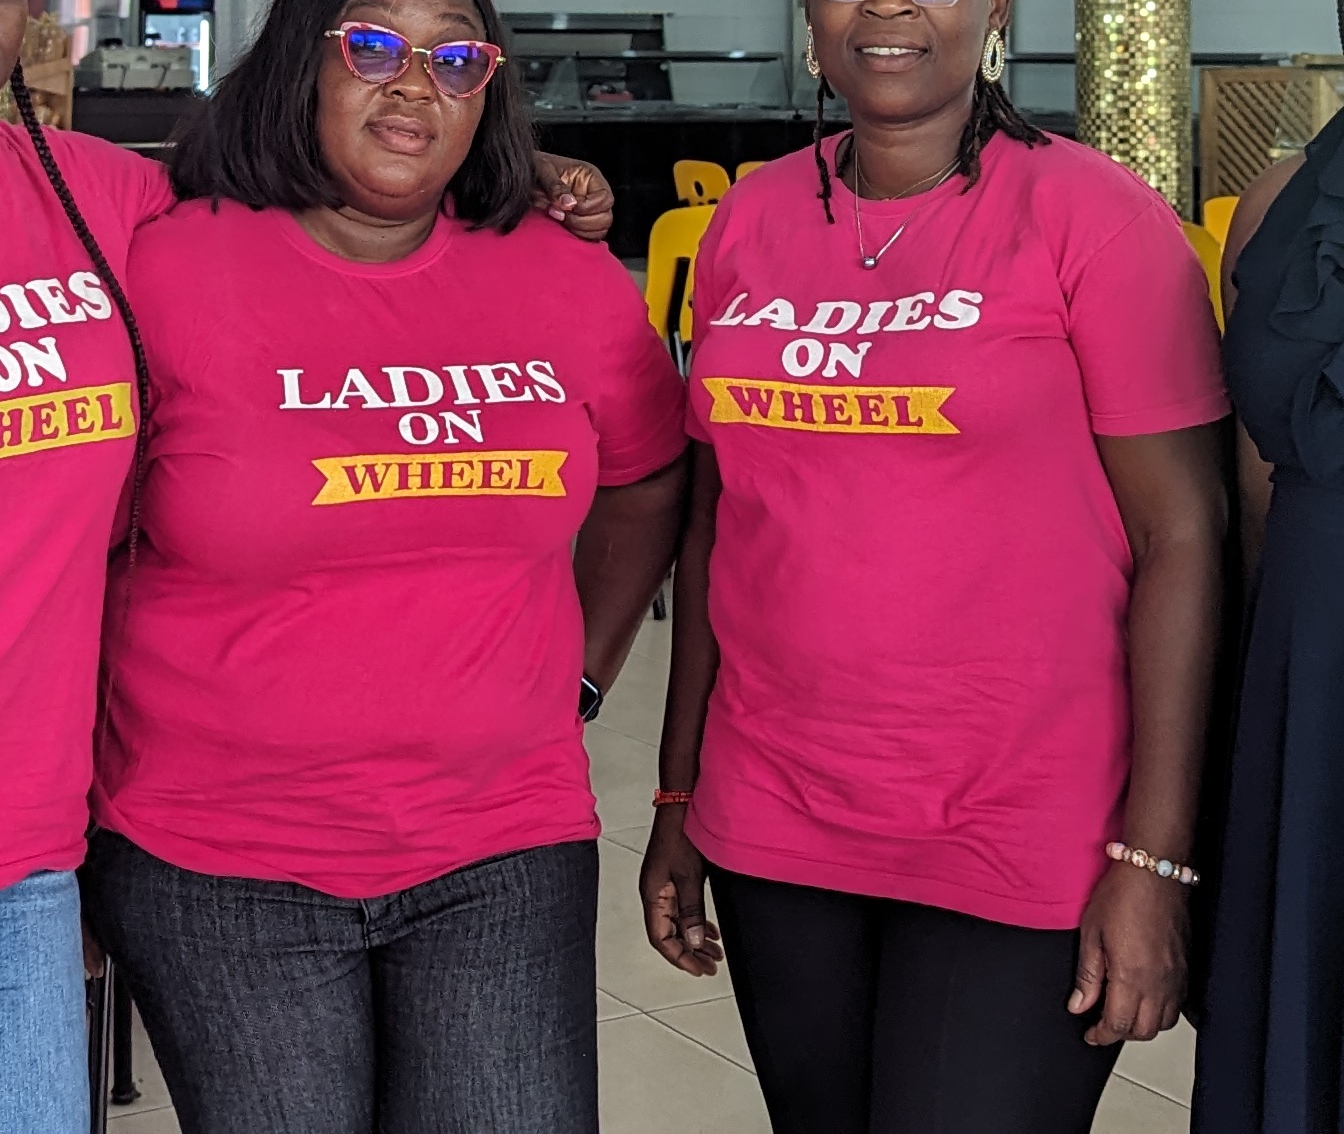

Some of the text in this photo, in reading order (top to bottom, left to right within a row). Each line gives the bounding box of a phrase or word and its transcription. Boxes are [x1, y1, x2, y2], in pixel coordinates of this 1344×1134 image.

[711, 290, 983, 334] LADIES
[782, 338, 872, 378] ON
[277, 361, 565, 409] LADIES
[726, 386, 923, 426] WHEEL
[399, 410, 483, 444] ON
[342, 459, 544, 494] WHEEL
